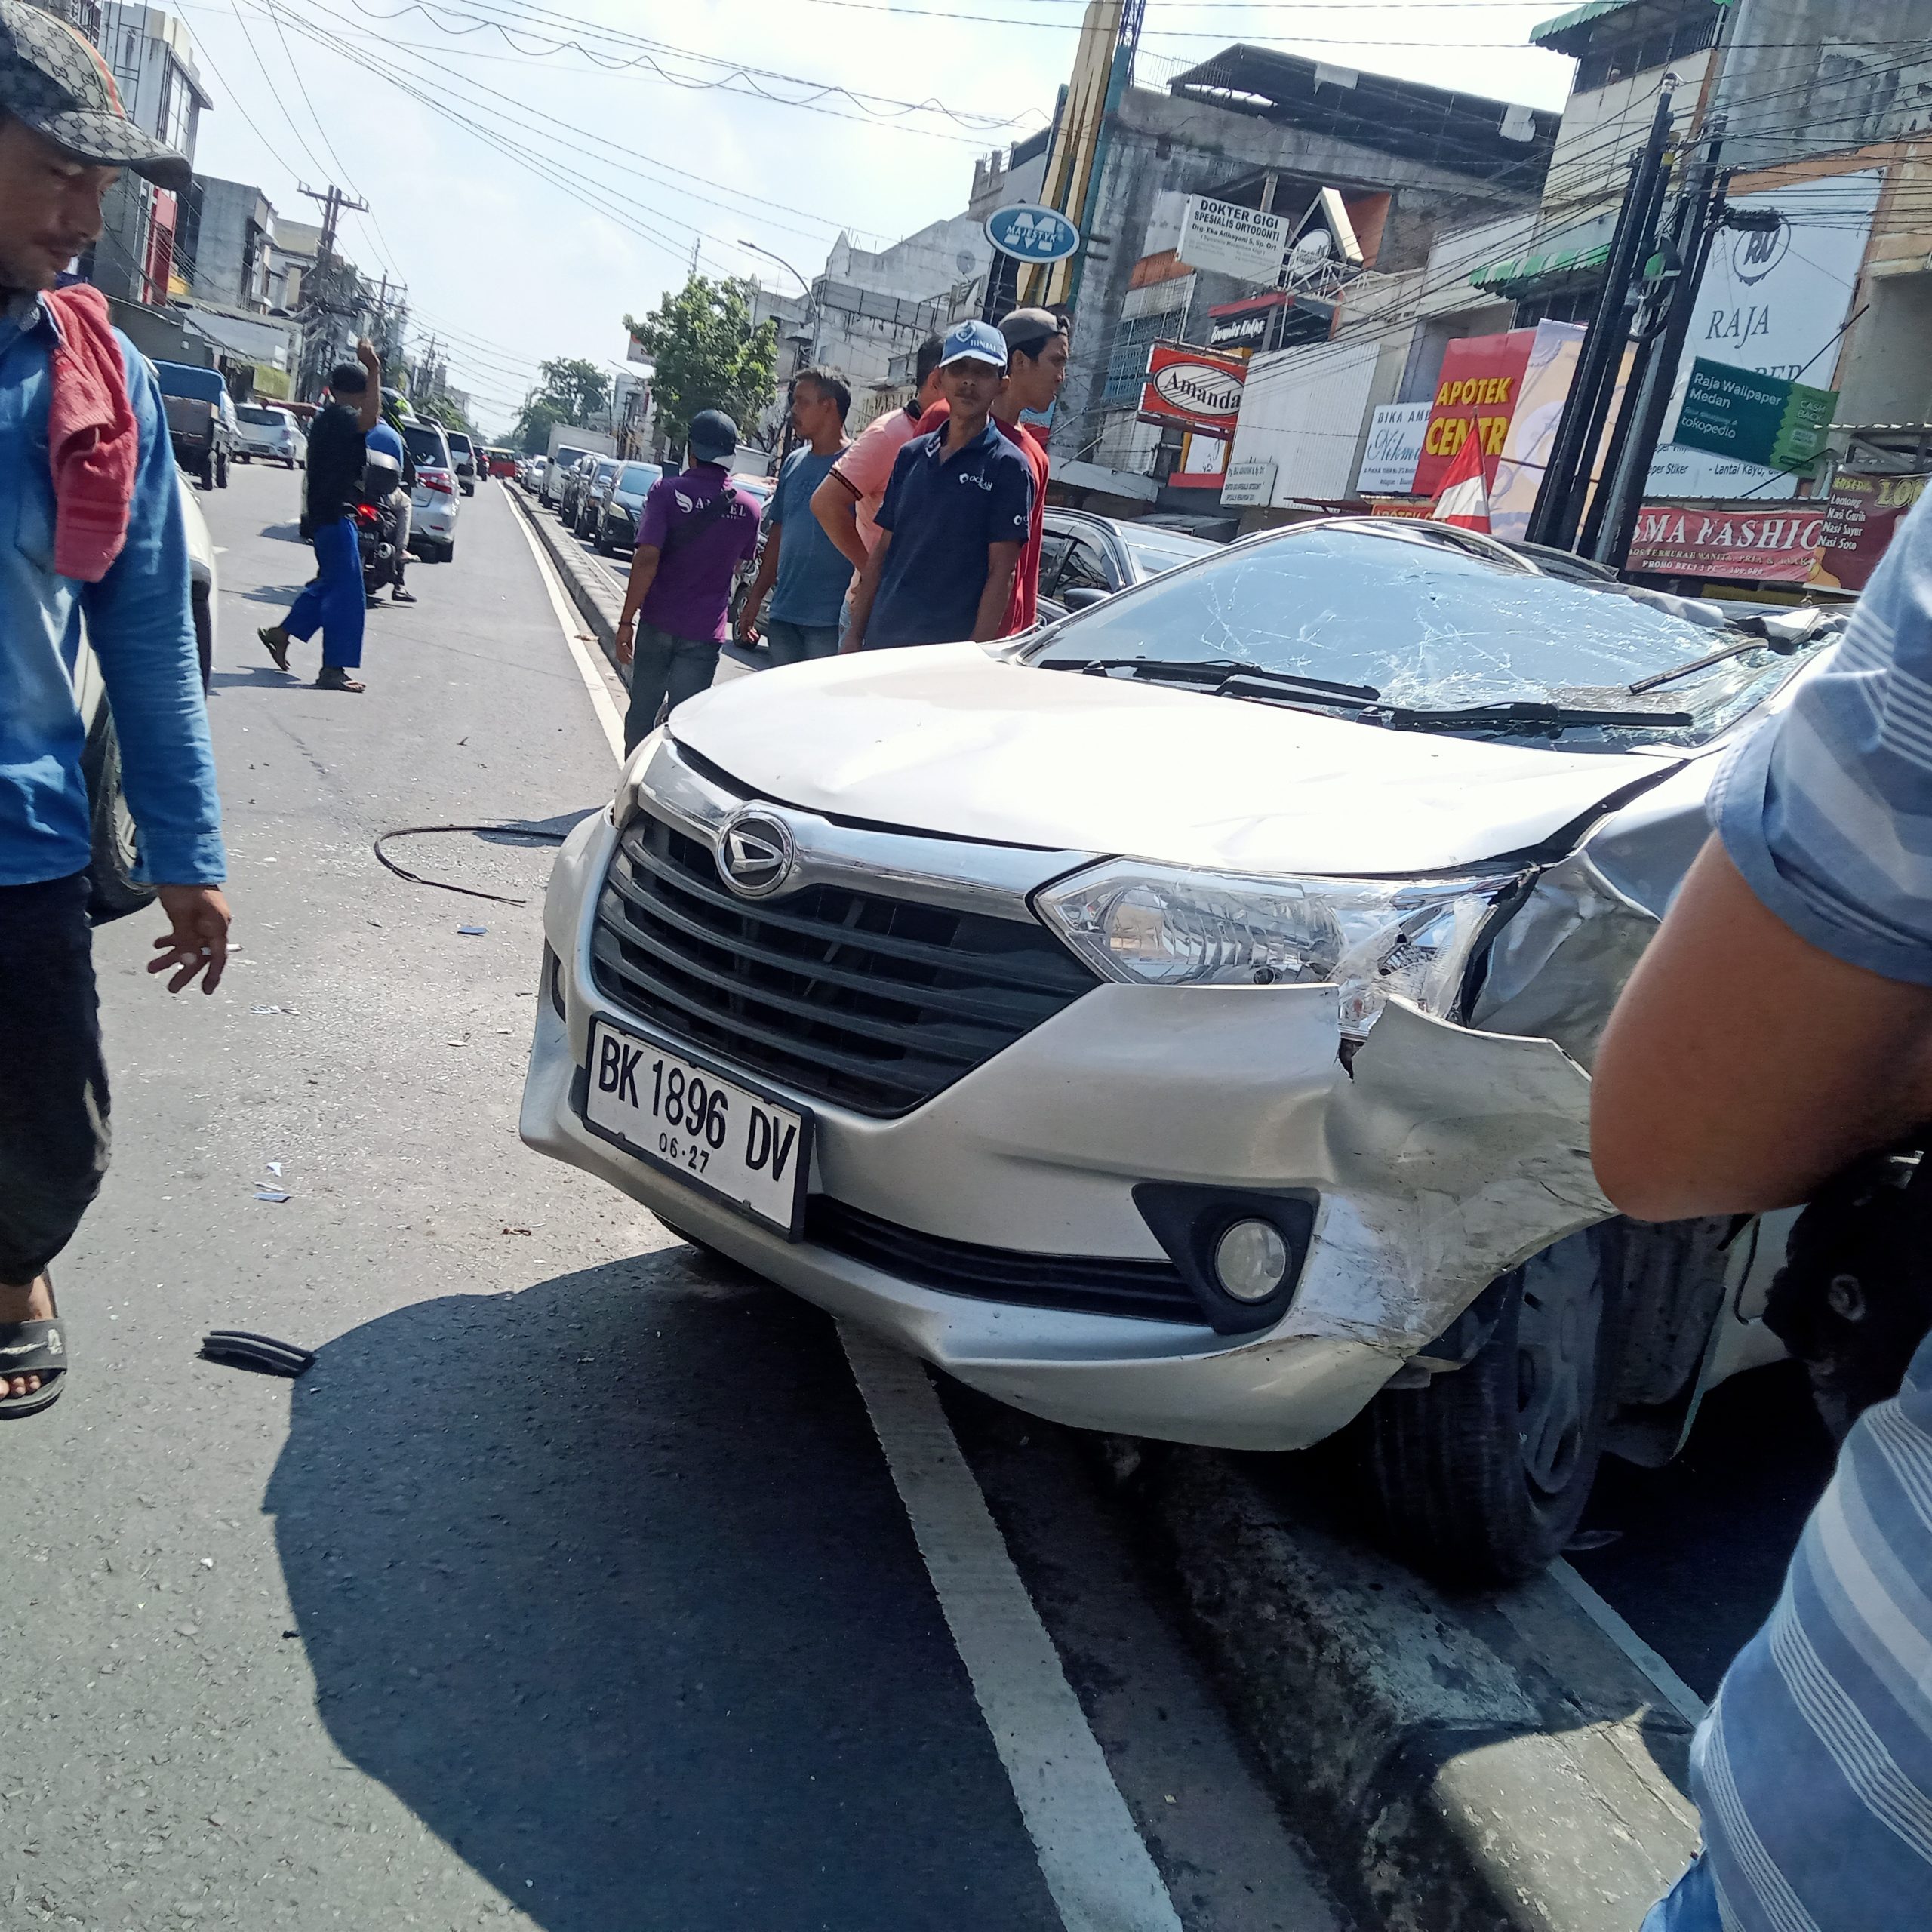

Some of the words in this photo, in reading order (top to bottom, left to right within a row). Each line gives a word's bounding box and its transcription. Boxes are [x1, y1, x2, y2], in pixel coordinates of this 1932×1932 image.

[1201, 199, 1249, 222] DOKTER
[1253, 213, 1278, 229] GIGI
[1005, 225, 1057, 243] MAJESTYK
[1194, 211, 1234, 229] SPESIALIS
[1235, 222, 1281, 242] ORTODONTI
[1705, 304, 1769, 349] RAJA
[1164, 371, 1241, 410] Amanda
[1436, 377, 1512, 406] APOTEK
[1694, 372, 1721, 391] Raja
[1723, 380, 1782, 406] Wallpaper
[1690, 388, 1731, 409] Medan
[1800, 399, 1826, 414] CASH
[1377, 411, 1403, 423] BIKA
[1797, 409, 1822, 423] BACK
[1681, 417, 1736, 438] tokopedia
[1425, 417, 1509, 457] CENTR
[1666, 463, 1689, 475] Stiker
[1714, 463, 1740, 475] Lantai
[1742, 463, 1765, 477] Kayu,
[1830, 494, 1862, 509] Lontong
[1826, 508, 1844, 520] Nasi
[1845, 511, 1866, 521] Gurih
[1822, 521, 1842, 534] Nasi
[1843, 524, 1863, 537] Sayur
[1817, 535, 1836, 548] Nasi
[1838, 538, 1857, 550] Soto
[1642, 560, 1673, 568] PROMO
[1675, 562, 1697, 571] BELI
[599, 1035, 644, 1109] BK
[653, 1060, 728, 1149] 1896
[746, 1106, 797, 1182] DV
